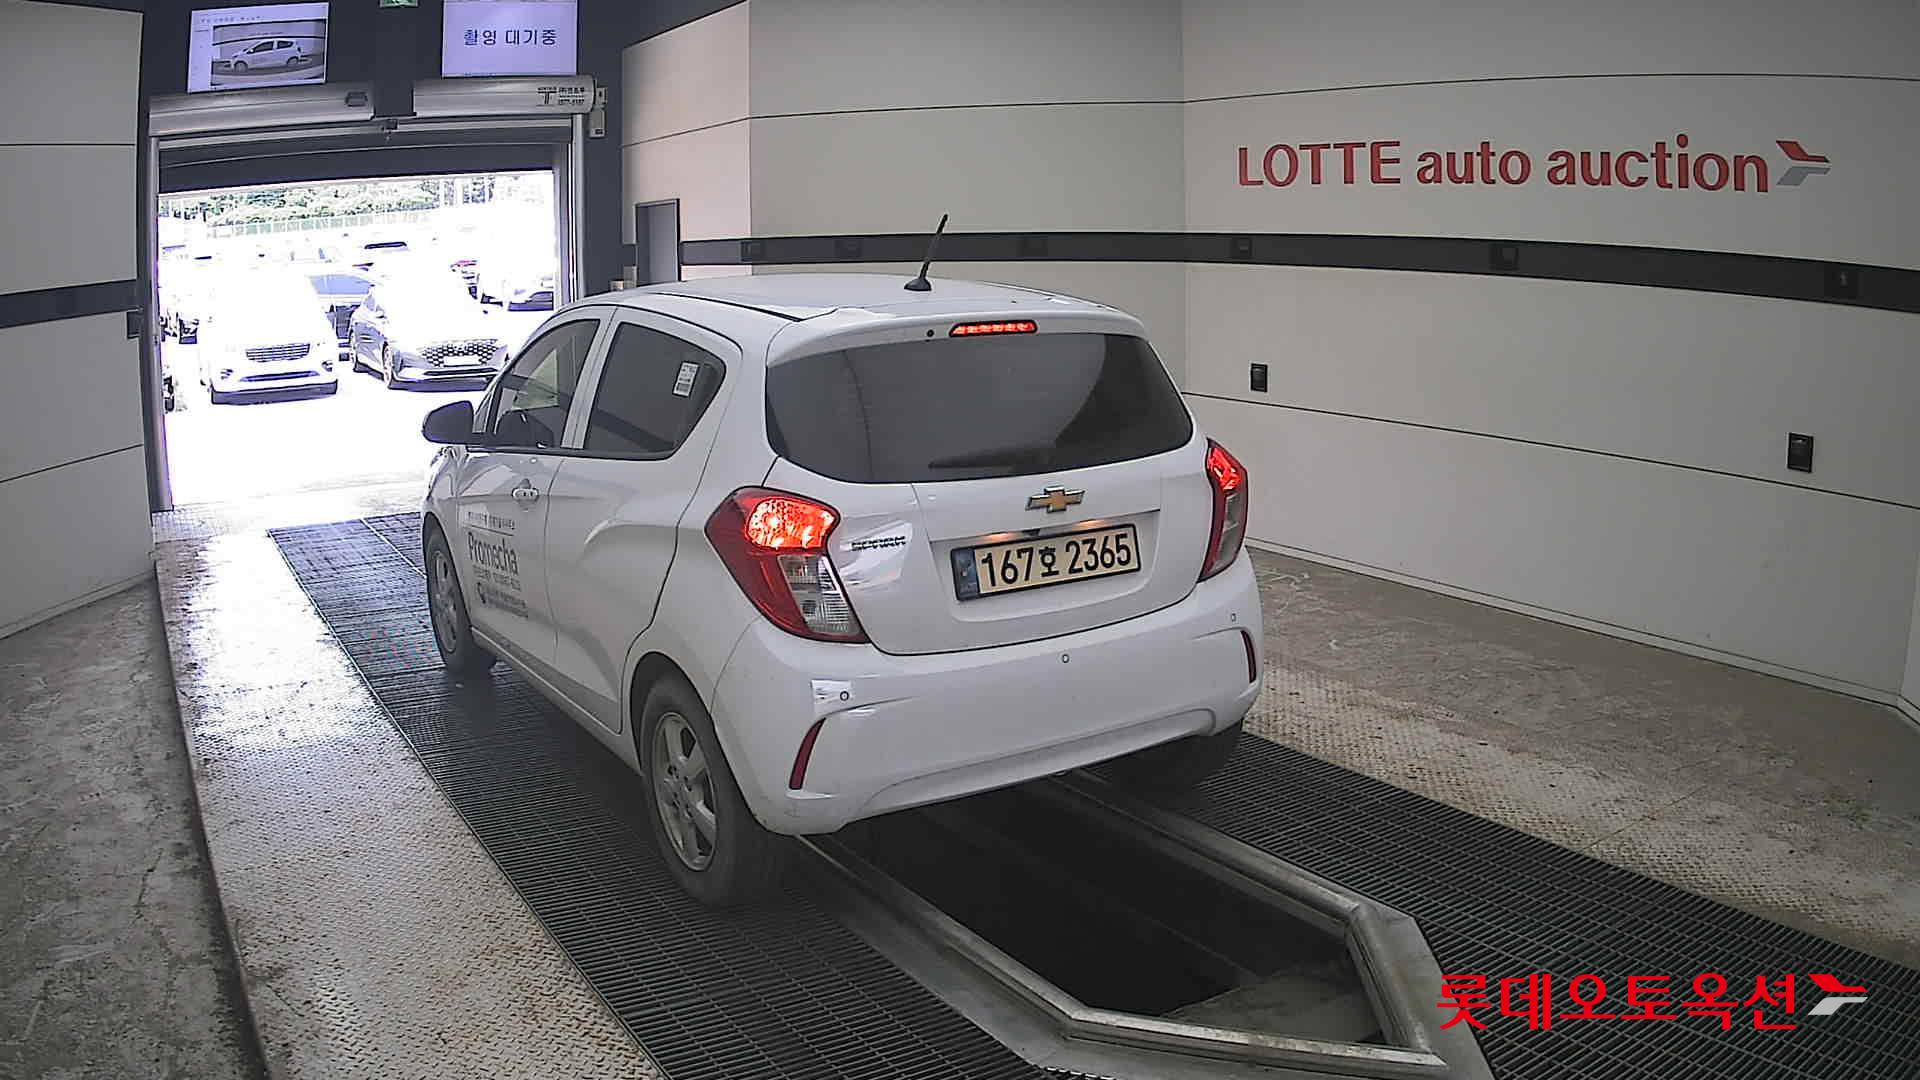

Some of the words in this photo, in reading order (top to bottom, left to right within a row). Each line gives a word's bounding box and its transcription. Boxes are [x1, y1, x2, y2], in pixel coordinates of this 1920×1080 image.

[505, 29, 558, 46] 대기중
[1238, 140, 1401, 187] LOTTE
[1415, 141, 1532, 186] auto
[1546, 134, 1769, 193] auction
[981, 546, 1061, 588] 167호
[1065, 533, 1132, 575] 2365
